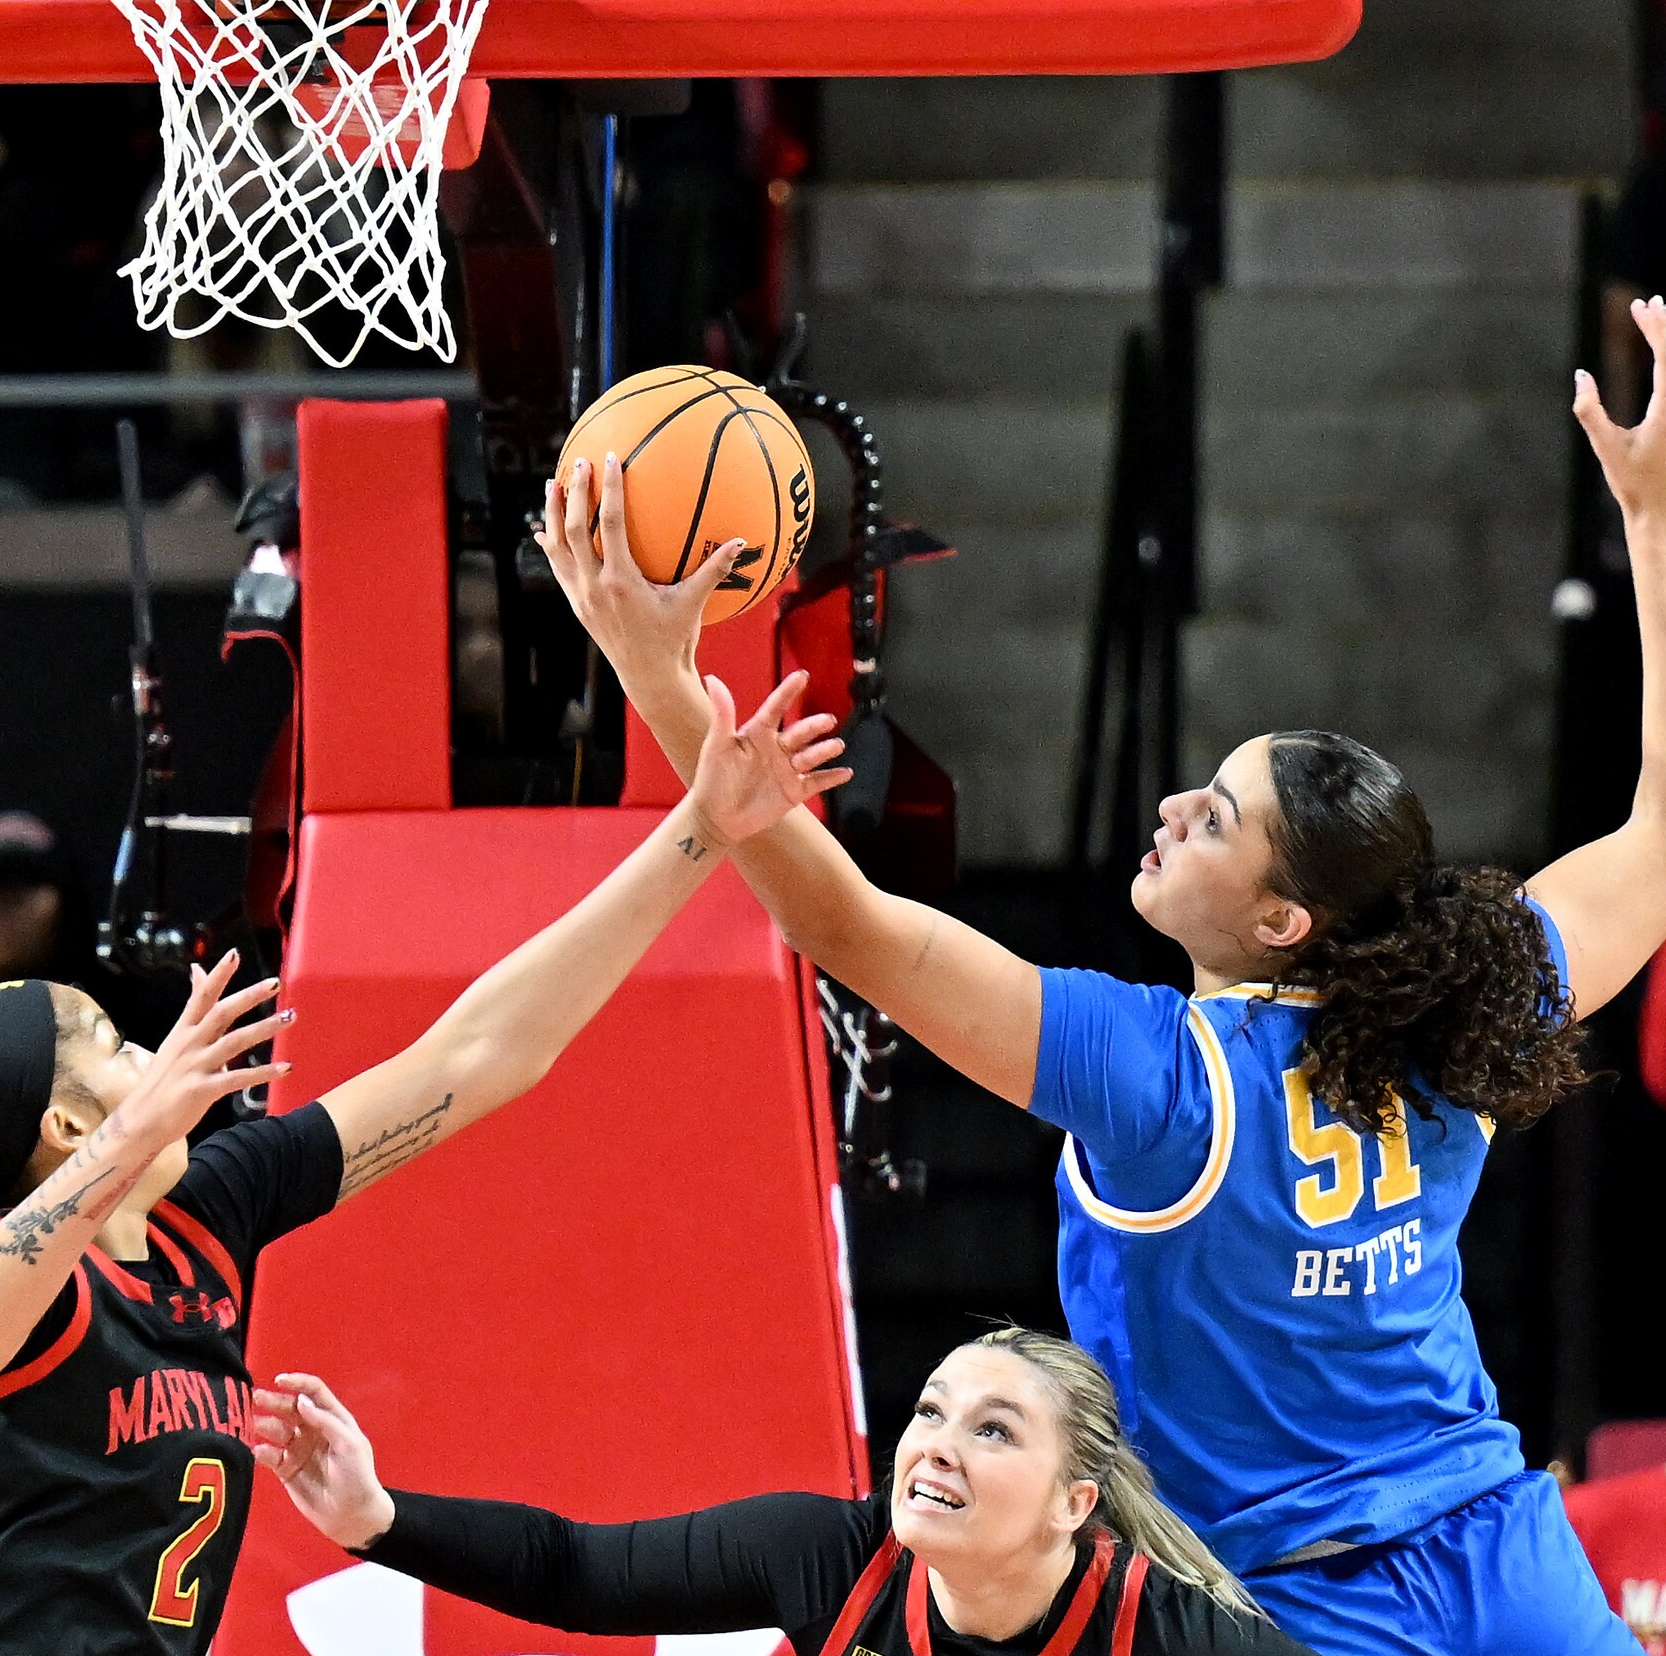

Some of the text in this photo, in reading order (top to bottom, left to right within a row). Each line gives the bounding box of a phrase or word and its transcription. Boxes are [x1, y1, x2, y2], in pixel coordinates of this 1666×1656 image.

[1281, 1067, 1421, 1229] 51
[1291, 1217, 1422, 1297] BETTS
[104, 1368, 255, 1456] MARYLA
[147, 1457, 226, 1628] 2
